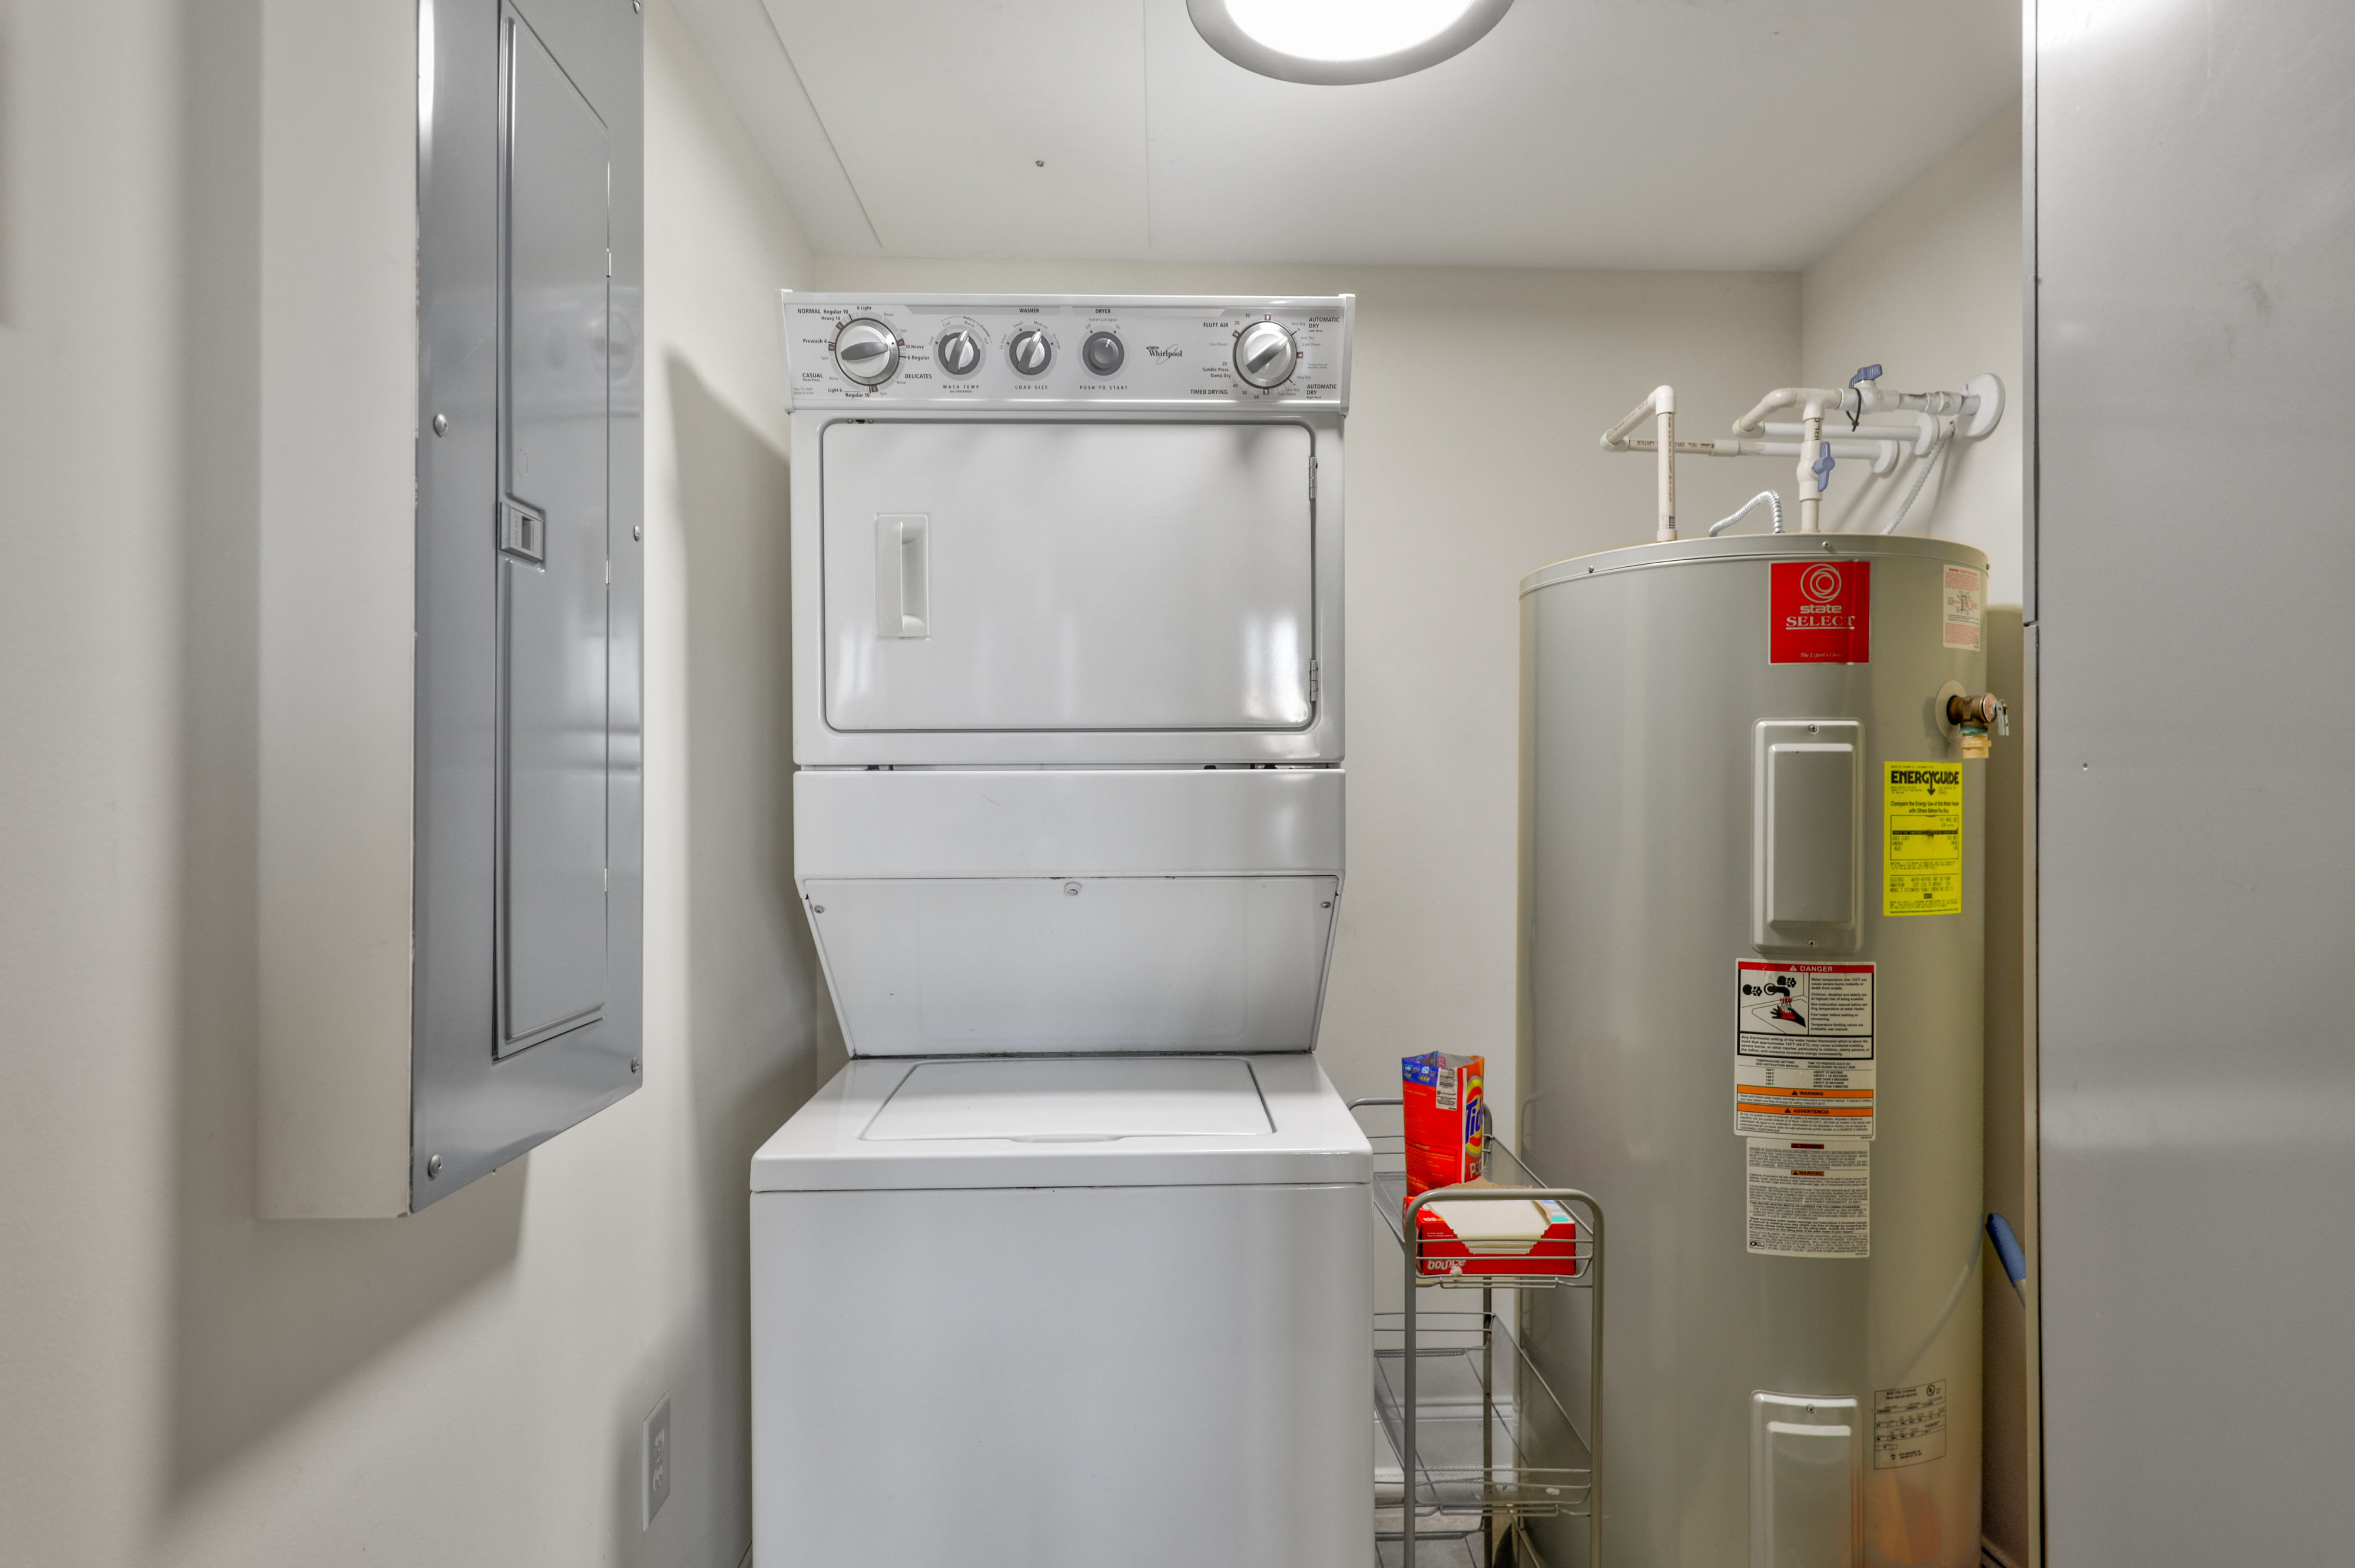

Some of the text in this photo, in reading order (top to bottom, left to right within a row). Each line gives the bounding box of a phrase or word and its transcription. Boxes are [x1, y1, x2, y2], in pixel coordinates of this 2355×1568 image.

[1034, 321, 1048, 329] Medium
[1800, 604, 1842, 613] state
[1786, 616, 1856, 626] SELECT
[1465, 1095, 1482, 1144] Tid
